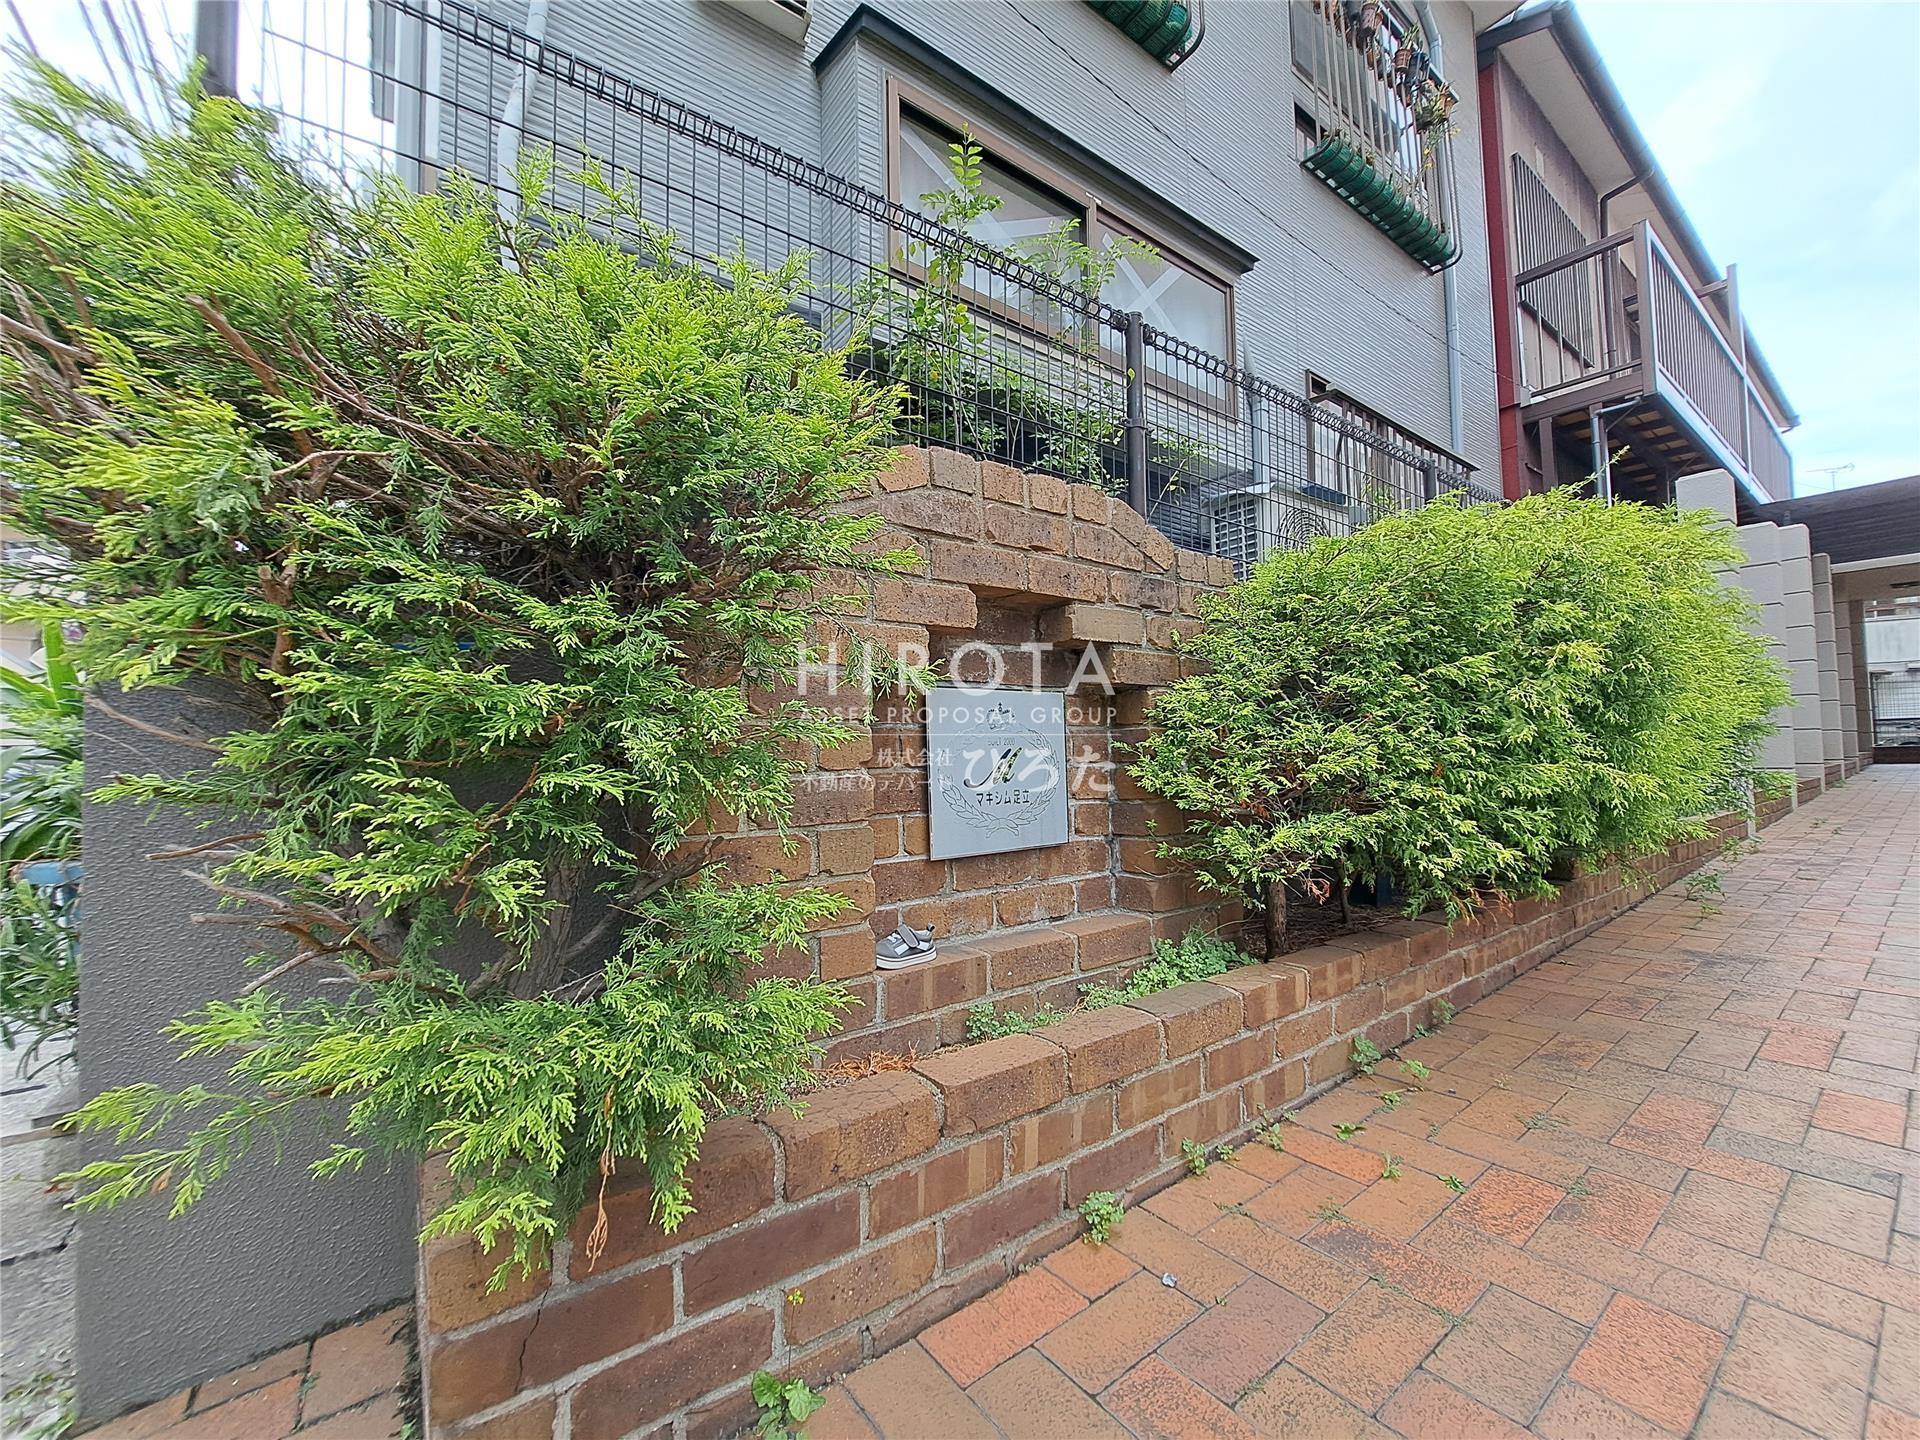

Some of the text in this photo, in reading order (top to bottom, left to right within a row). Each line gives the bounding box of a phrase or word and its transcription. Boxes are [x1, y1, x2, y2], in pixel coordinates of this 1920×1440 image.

[976, 789, 1030, 806] マキシム足立
